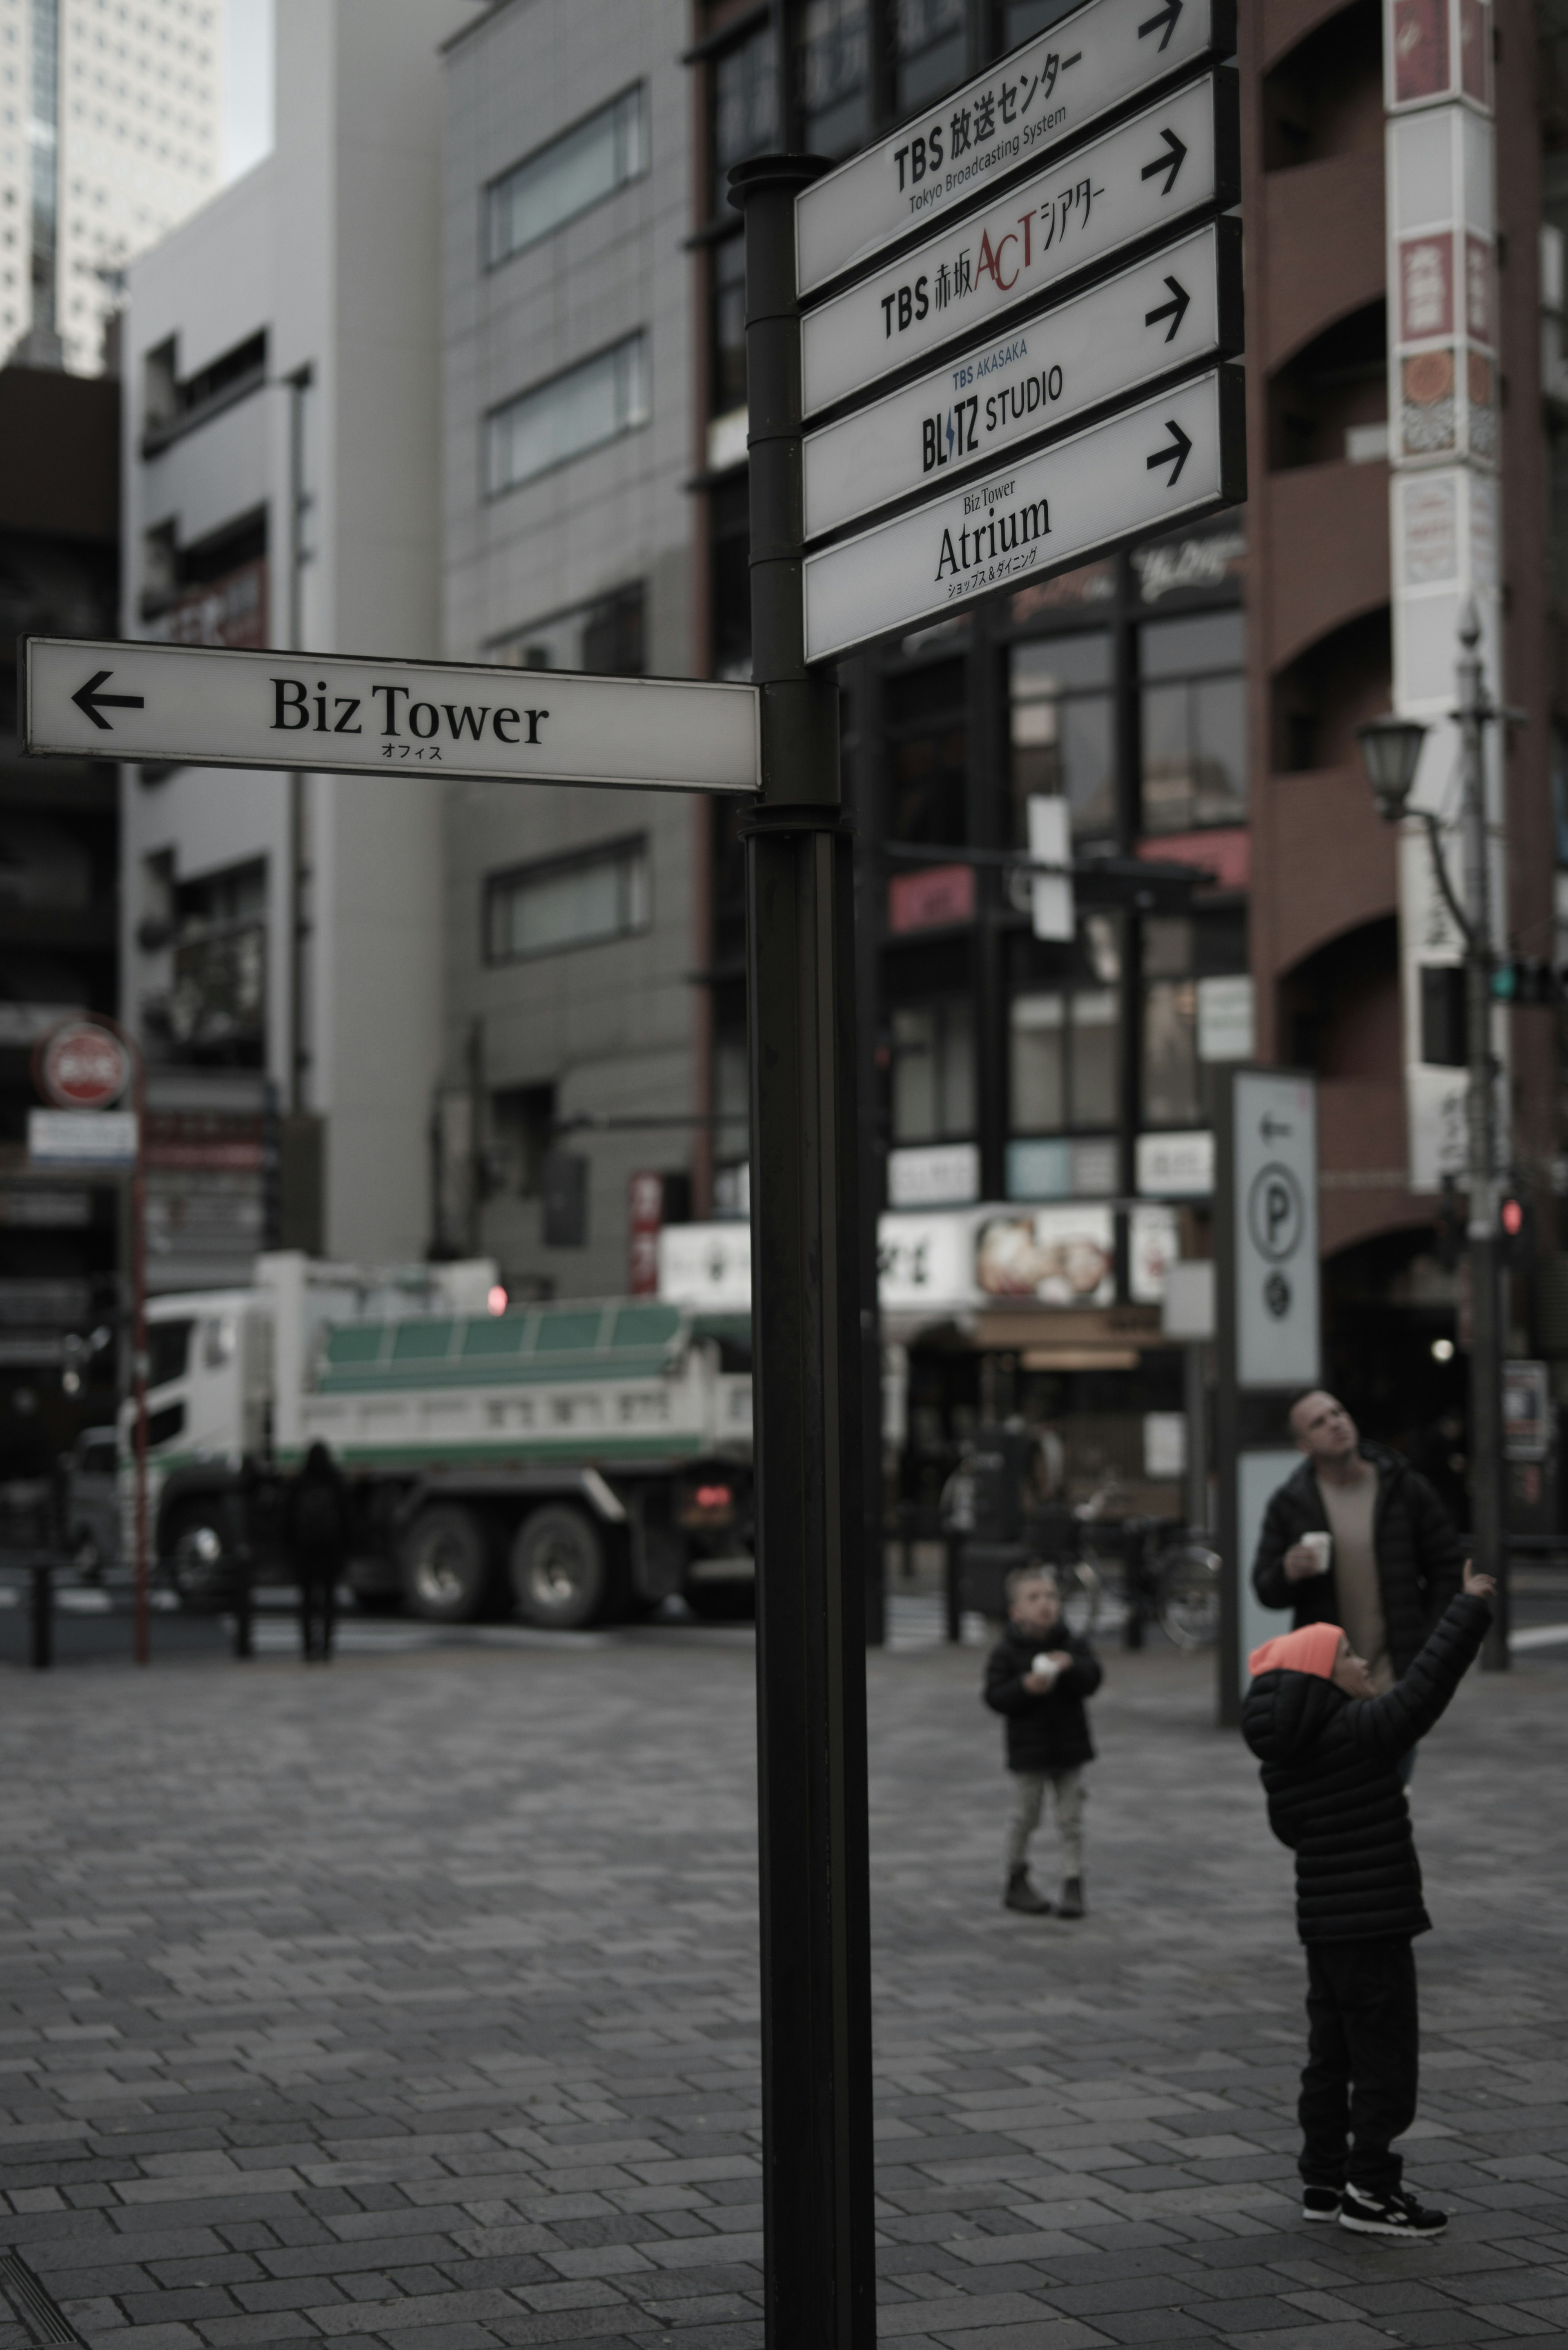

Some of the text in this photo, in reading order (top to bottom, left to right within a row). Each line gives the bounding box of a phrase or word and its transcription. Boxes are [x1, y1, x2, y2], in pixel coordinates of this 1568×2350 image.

[894, 51, 1082, 193] TBS 放送センター
[909, 106, 1066, 213] Tokyo Broadcasting System
[881, 276, 929, 339] TBS
[953, 339, 1027, 391] TBS AKASAKA
[986, 365, 1062, 431] STUDIO
[963, 480, 1015, 515] Biz Tower
[934, 499, 1052, 582] Atrium
[270, 678, 550, 745] Biz Tower
[382, 743, 442, 760] オフィス
